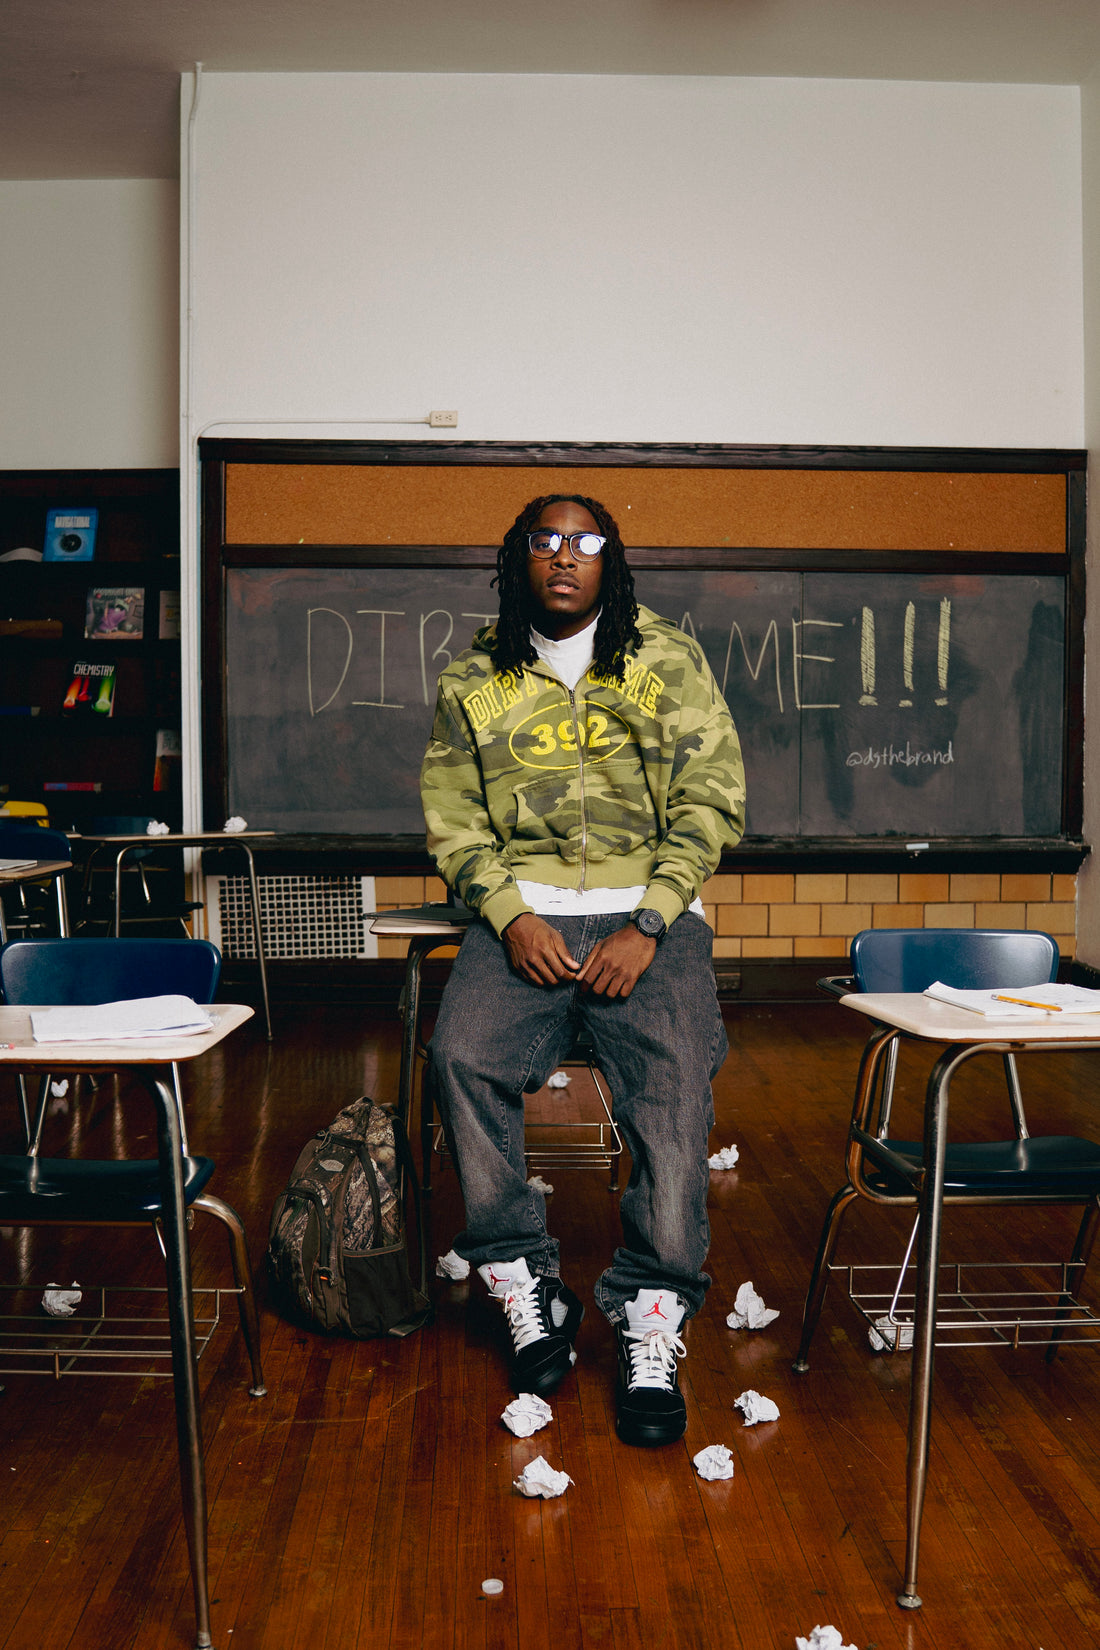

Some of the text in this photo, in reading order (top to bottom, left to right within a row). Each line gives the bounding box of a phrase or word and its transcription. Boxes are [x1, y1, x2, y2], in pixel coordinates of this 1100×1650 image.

[73, 663, 115, 677] CHEMISTRY
[680, 596, 952, 713] ME!!!
[529, 714, 611, 756] 392
